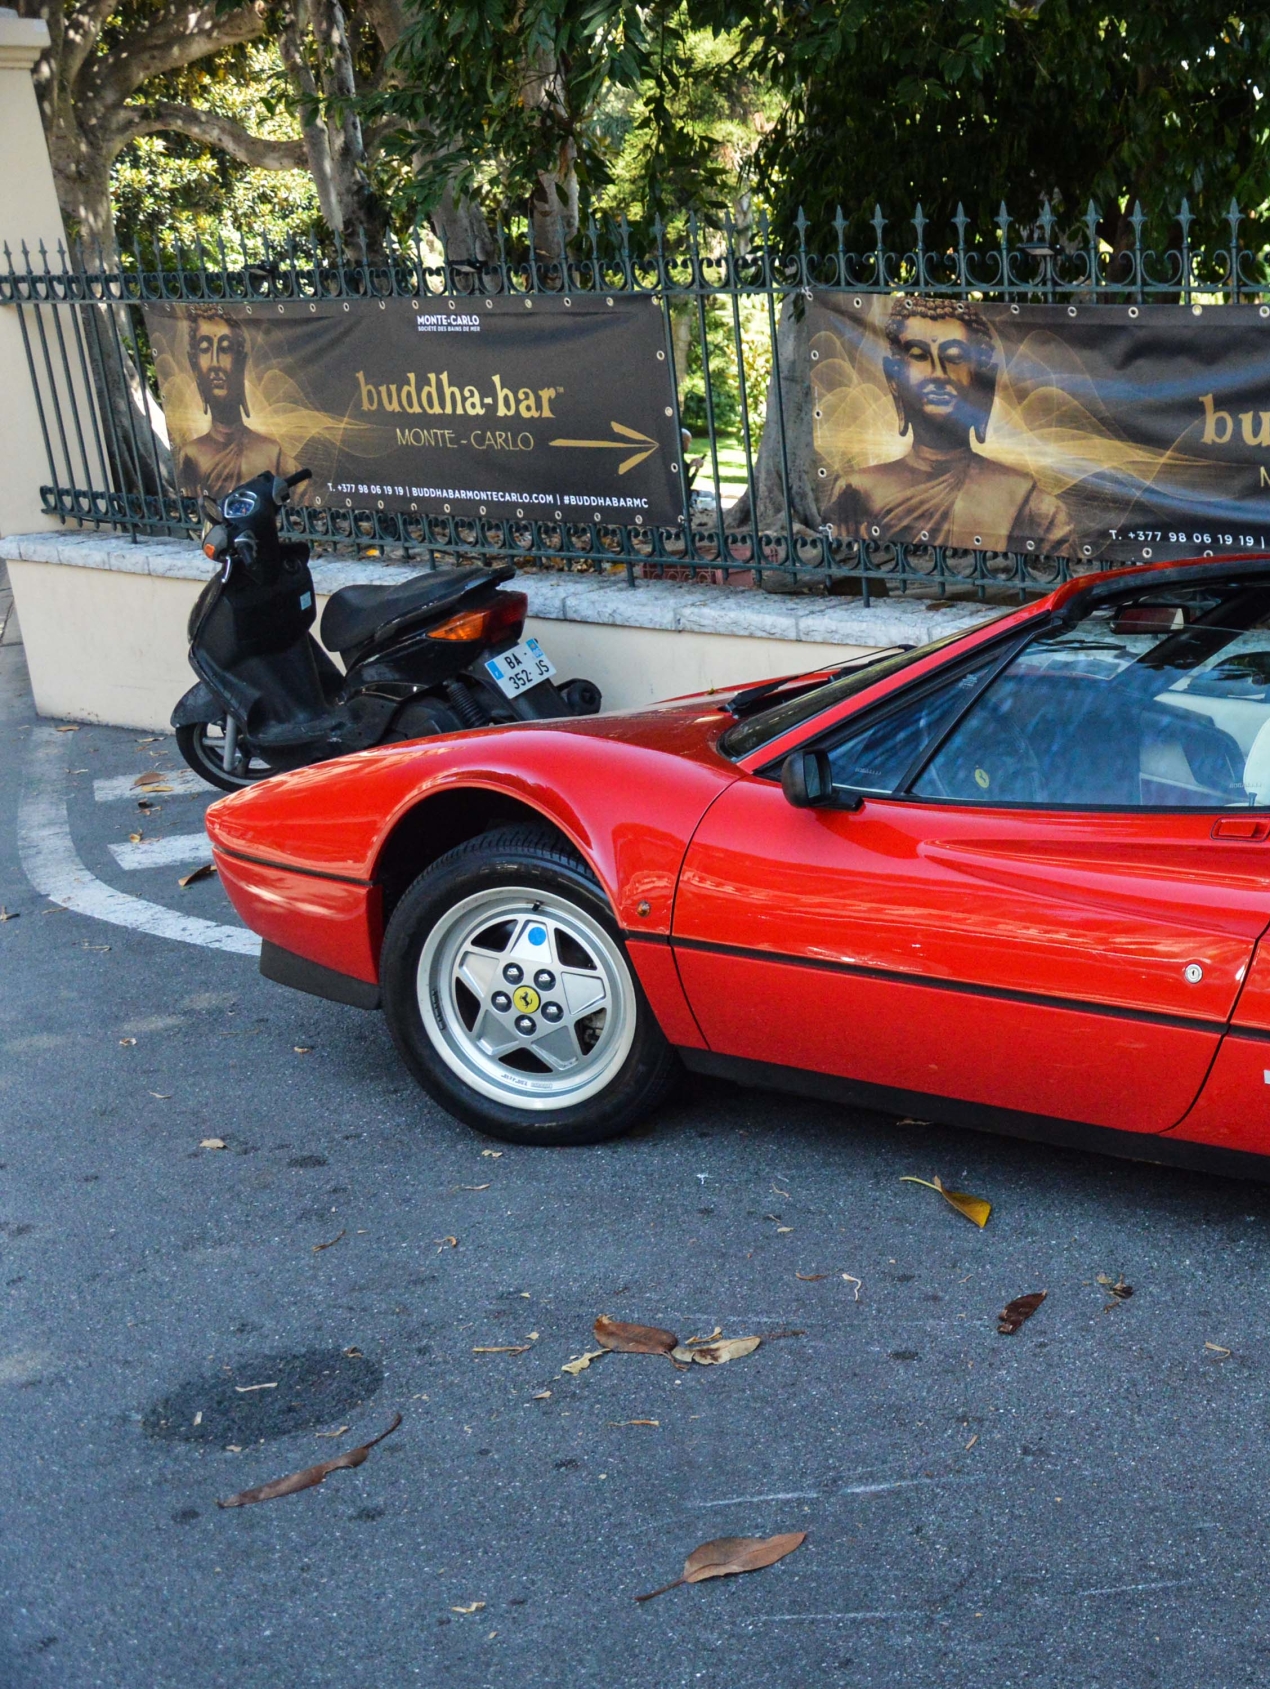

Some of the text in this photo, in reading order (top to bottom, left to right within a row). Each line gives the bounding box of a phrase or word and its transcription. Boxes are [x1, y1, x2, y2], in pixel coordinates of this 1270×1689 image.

[396, 428, 458, 448] MONTE
[470, 430, 534, 450] CARLO
[327, 483, 335, 492] T.
[338, 483, 355, 493] +377
[358, 484, 368, 494] 98
[370, 485, 381, 494] 06
[384, 486, 392, 495] 19
[394, 486, 404, 496] 19
[412, 487, 554, 504] BUDDHABARMONTECARLO.COM
[564, 496, 648, 508] #BUDDHABARMC
[1109, 530, 1122, 540] T.
[1128, 531, 1162, 542] +377
[1169, 532, 1186, 543] 98
[1193, 533, 1212, 543] 06
[1217, 534, 1232, 545] 19
[1239, 535, 1254, 546] 19
